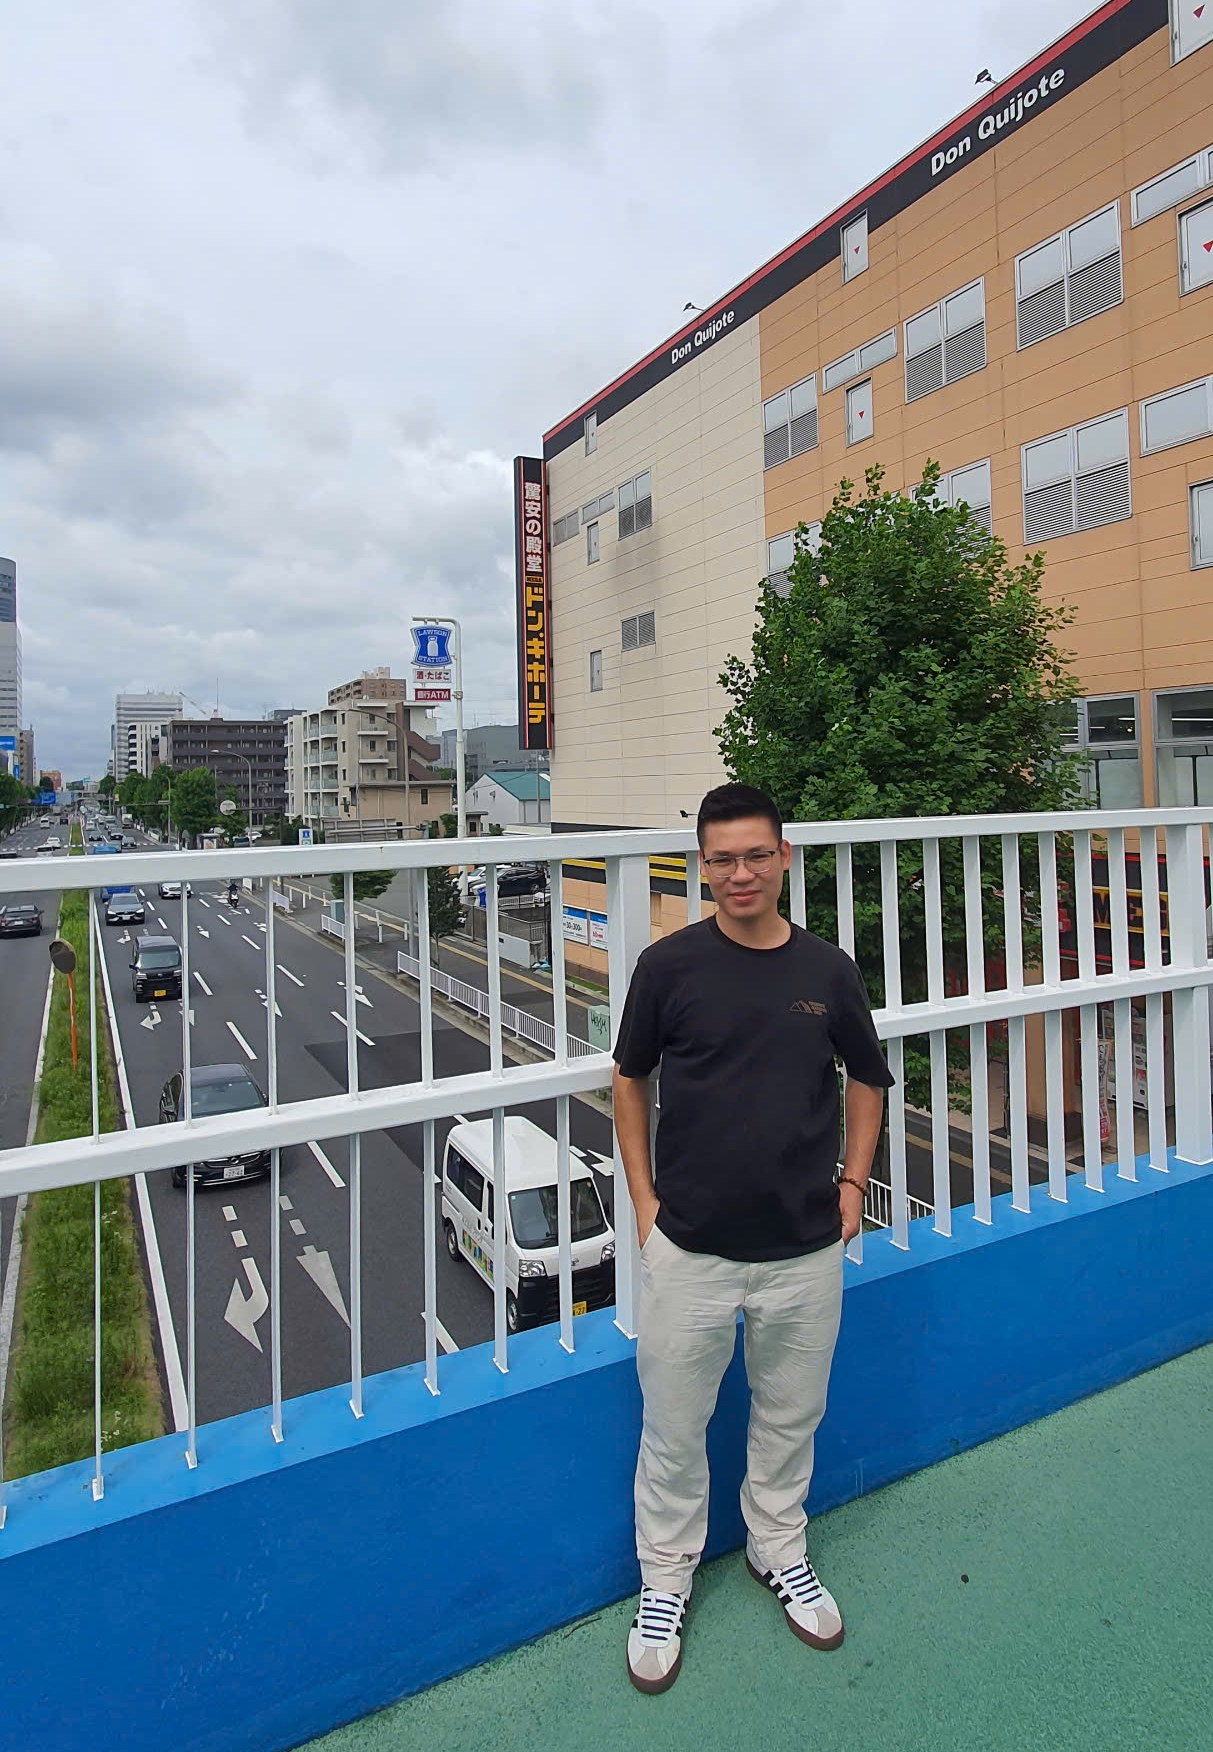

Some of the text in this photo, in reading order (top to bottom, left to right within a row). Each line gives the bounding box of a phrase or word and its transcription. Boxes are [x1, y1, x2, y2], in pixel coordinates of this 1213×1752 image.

[931, 69, 1065, 177] Don Quijote
[671, 310, 735, 365] Don Quijote
[524, 482, 542, 573] 驚安の殿堂
[417, 629, 448, 637] LAWSON
[418, 655, 448, 663] STATION
[526, 586, 546, 724] ドン・キホーテ
[417, 690, 449, 699] 銀行ATM
